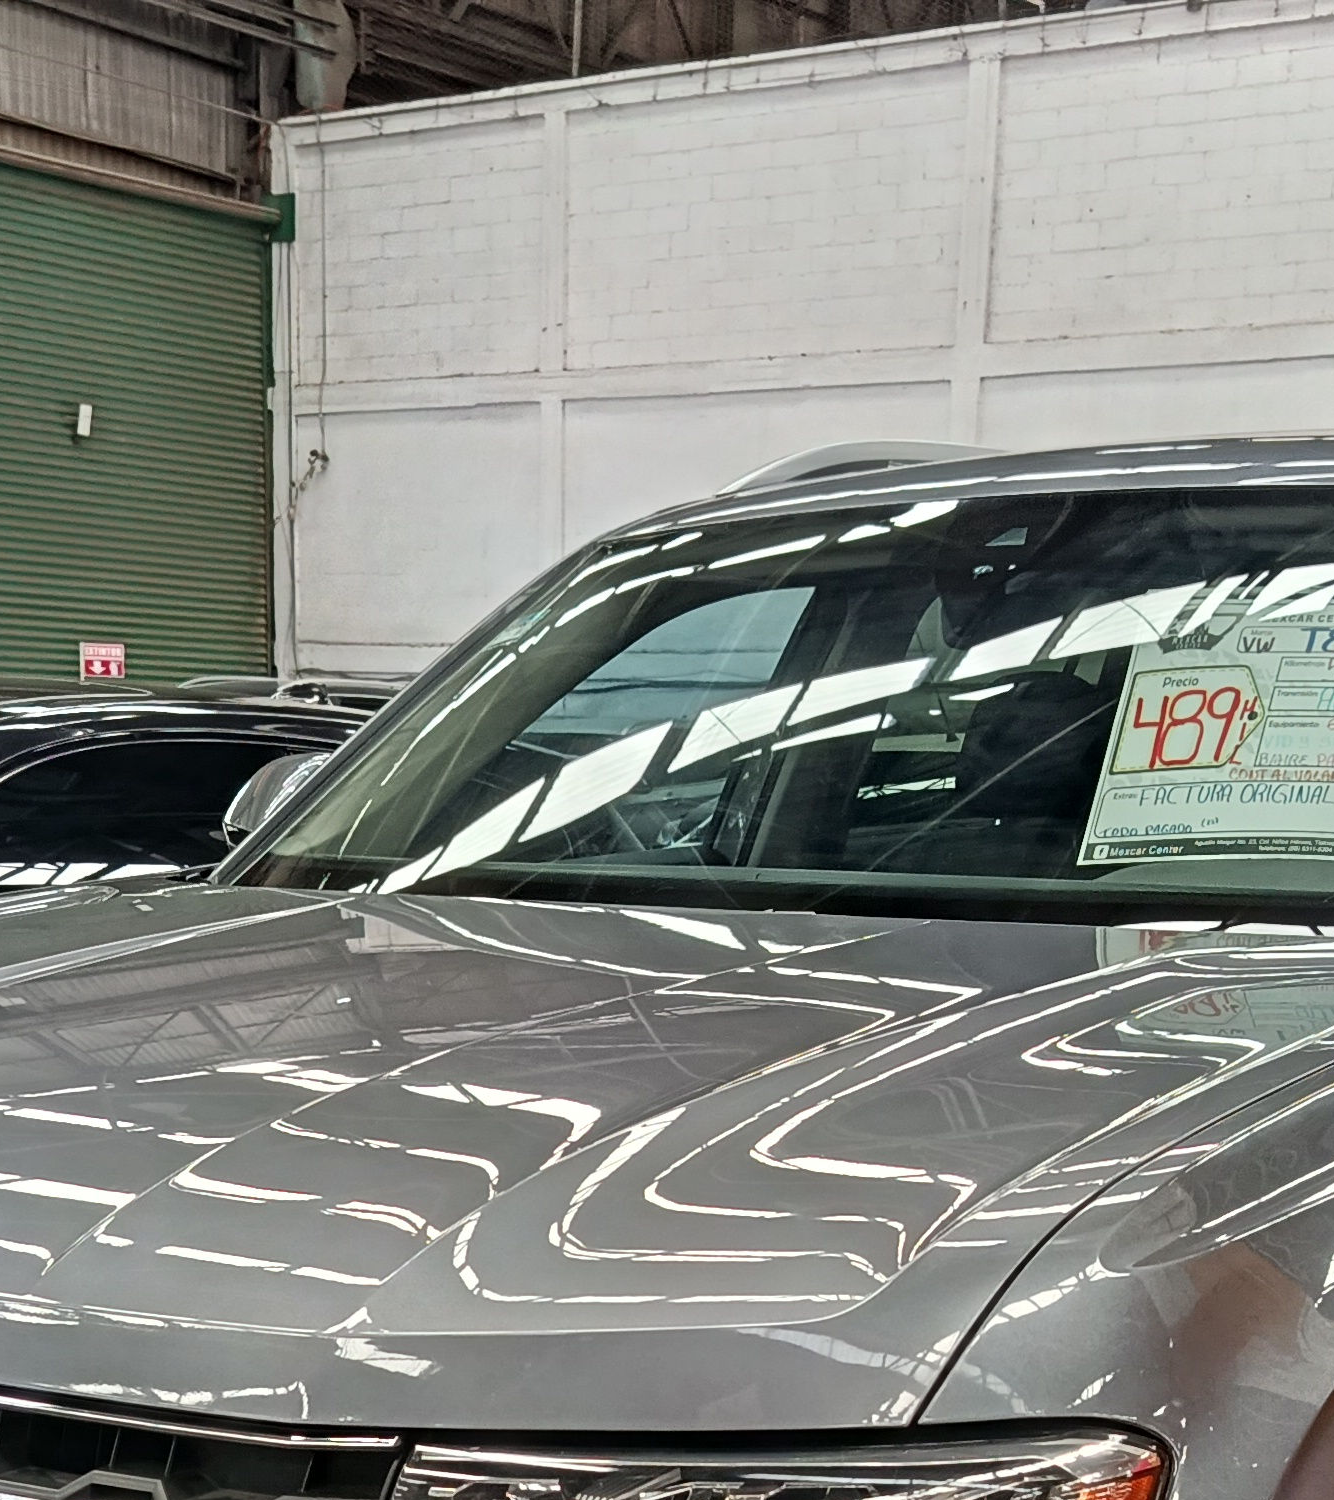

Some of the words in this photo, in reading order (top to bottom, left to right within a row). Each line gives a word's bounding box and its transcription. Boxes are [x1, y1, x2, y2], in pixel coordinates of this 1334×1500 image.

[1242, 636, 1276, 653] VW
[1162, 676, 1200, 688] Precio
[1133, 686, 1242, 770] 489
[1138, 783, 1233, 807] FACTURA
[1097, 827, 1139, 840] TODO
[1145, 822, 1194, 836] PAGADO
[1109, 846, 1147, 858] Mexcar
[1148, 844, 1184, 857] Center
